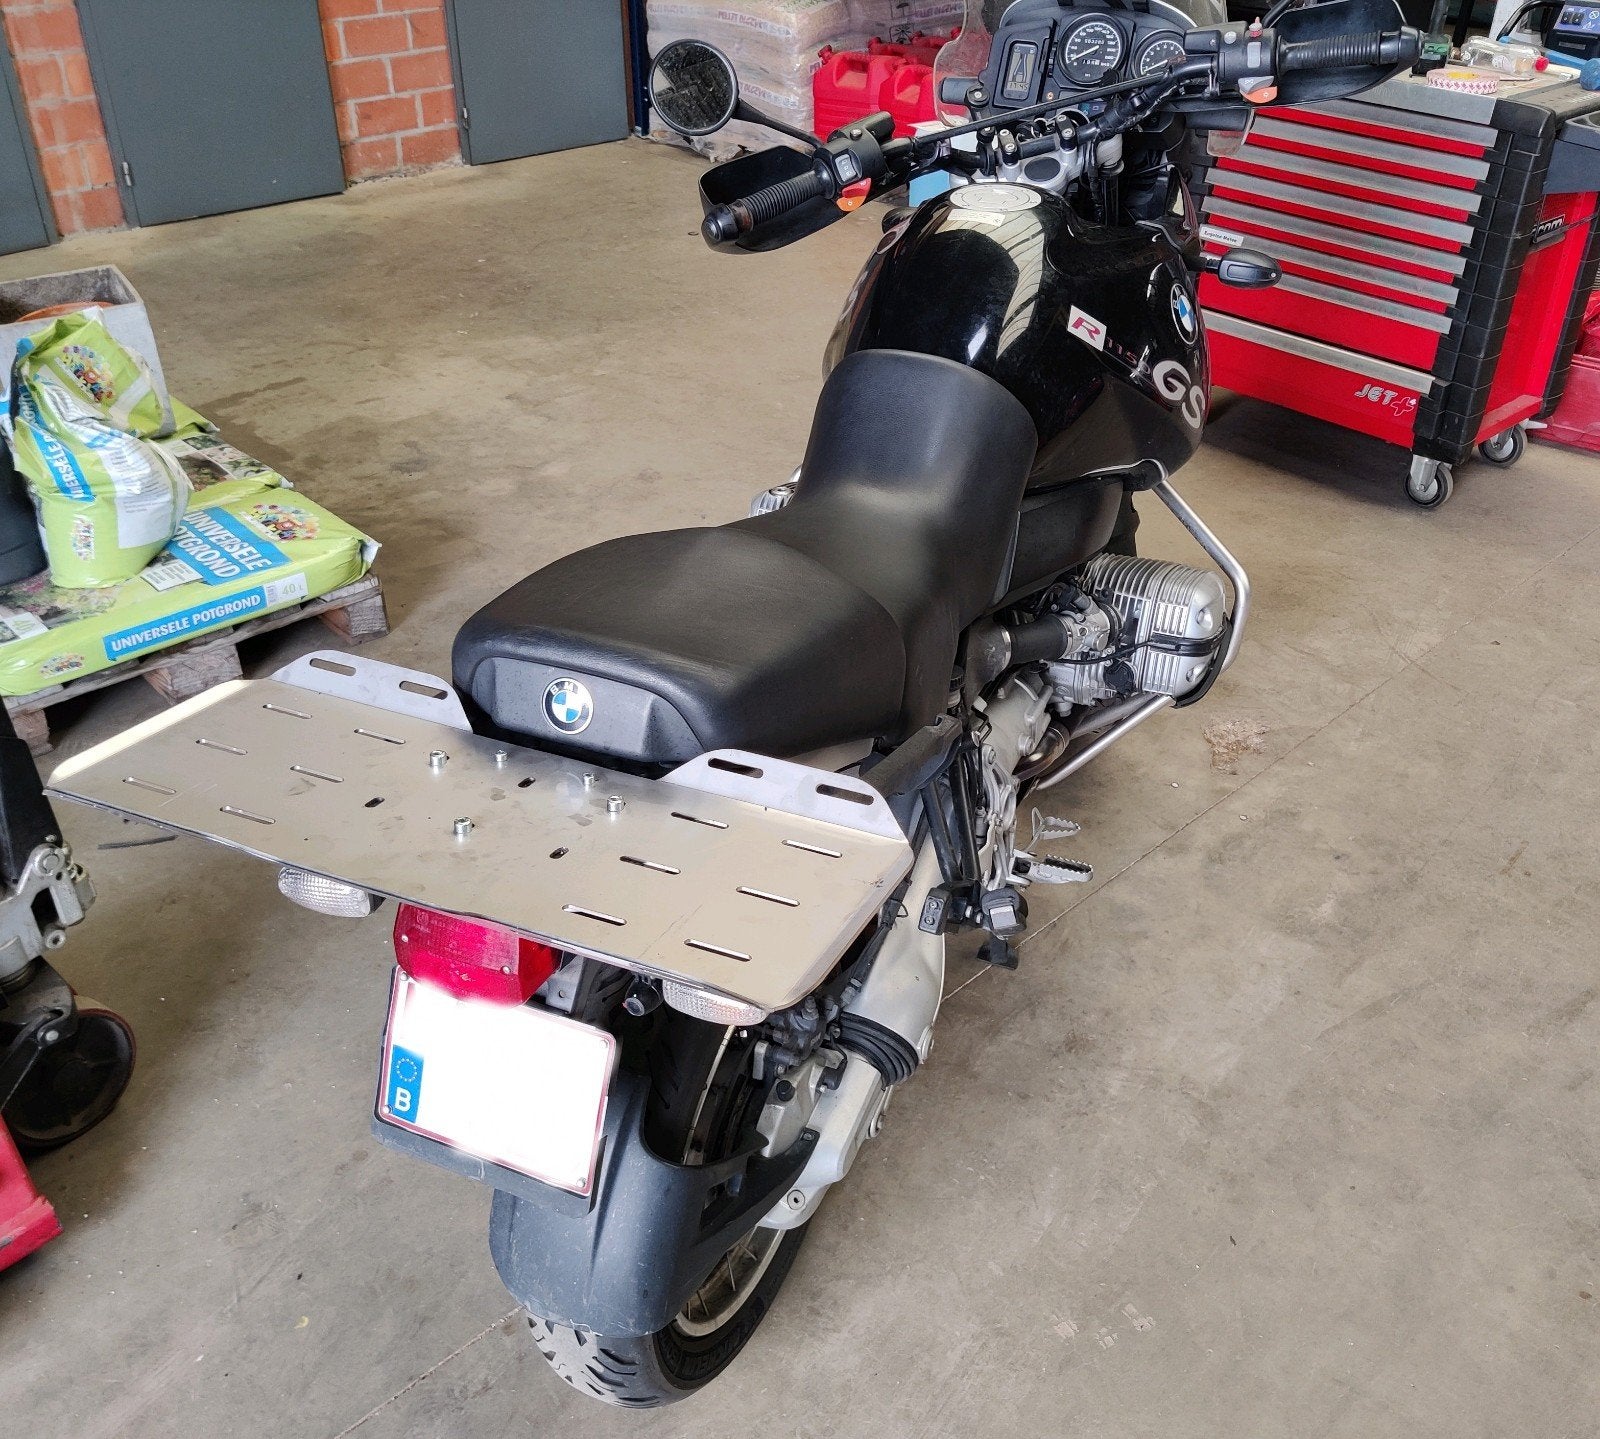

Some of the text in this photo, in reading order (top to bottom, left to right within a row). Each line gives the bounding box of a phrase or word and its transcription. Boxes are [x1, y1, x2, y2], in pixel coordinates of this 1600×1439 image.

[1152, 359, 1206, 429] GS
[182, 510, 273, 571] UNIVERSELE
[111, 594, 261, 652] UNIVERSELE POTGROND
[395, 1086, 411, 1112] B
